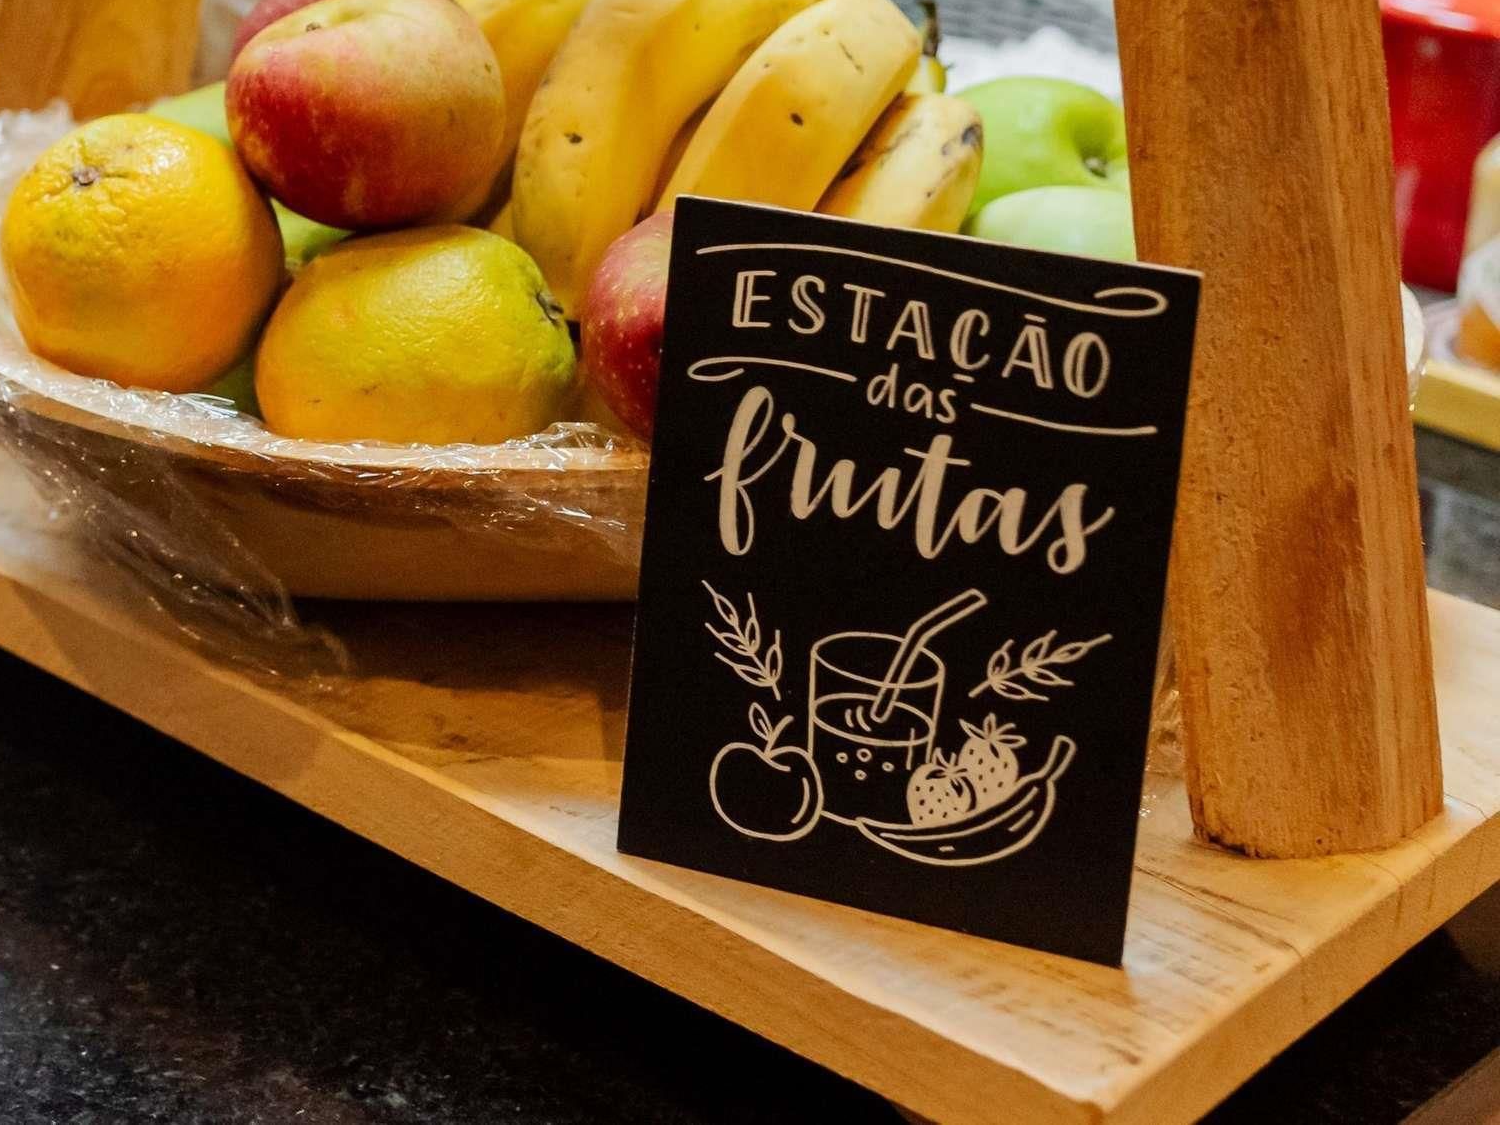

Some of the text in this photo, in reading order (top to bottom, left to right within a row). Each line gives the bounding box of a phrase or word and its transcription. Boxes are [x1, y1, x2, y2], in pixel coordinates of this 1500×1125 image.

[732, 269, 1110, 399] ESTAÇÃO
[866, 364, 958, 424] das
[703, 385, 1116, 575] frutas
